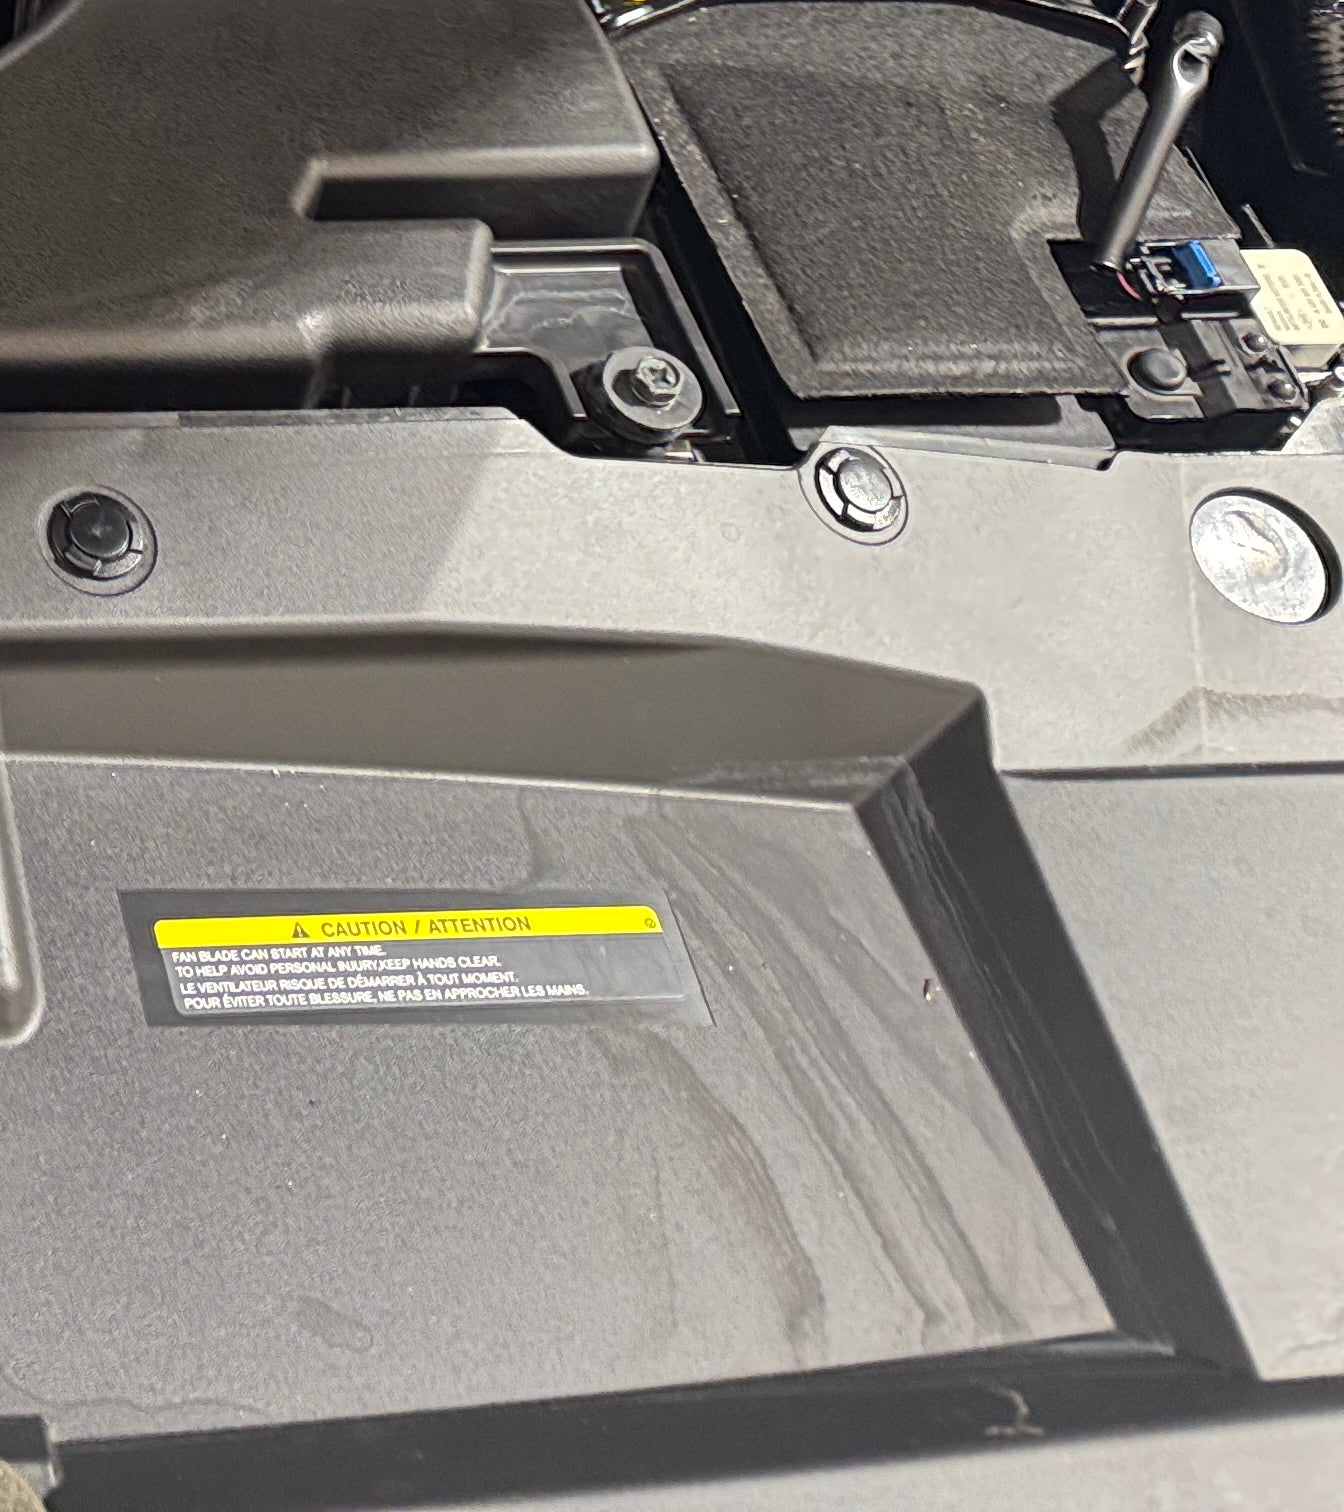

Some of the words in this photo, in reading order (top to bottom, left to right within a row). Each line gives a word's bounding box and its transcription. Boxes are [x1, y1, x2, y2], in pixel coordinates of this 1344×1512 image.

[321, 920, 407, 938] CAUTION
[414, 919, 421, 935] /
[429, 916, 532, 934] ATTENTION
[172, 951, 197, 963] FAN
[198, 949, 240, 962] BLADE
[241, 949, 269, 961] CAN
[270, 947, 307, 960] START
[311, 947, 325, 958] AT
[328, 946, 353, 958] ANY
[353, 945, 386, 957] TIME.
[175, 965, 194, 977] TO
[195, 965, 228, 977] HELP
[231, 963, 269, 975] AVOID
[269, 961, 337, 974] PERSONAL
[411, 956, 456, 969] HANDS
[457, 955, 502, 968] CLEAR.
[180, 982, 197, 995] LE
[197, 979, 279, 994] VENTILATEUR
[328, 977, 346, 989] DE
[347, 973, 416, 988] DÉMARRER
[417, 970, 428, 986] À
[427, 973, 459, 986] TOUT
[462, 971, 520, 984] MOMENT.
[184, 997, 222, 1009] POUR
[223, 993, 265, 1009] ÉVITER
[265, 993, 307, 1007] TOUTE
[309, 990, 377, 1006] BLESSURE,
[378, 989, 397, 1002] NE
[397, 988, 423, 1002] PAS
[424, 988, 442, 1001] EN
[444, 986, 522, 1000] APPROCHER
[521, 984, 546, 997] LES
[545, 983, 589, 997] MAINS.
